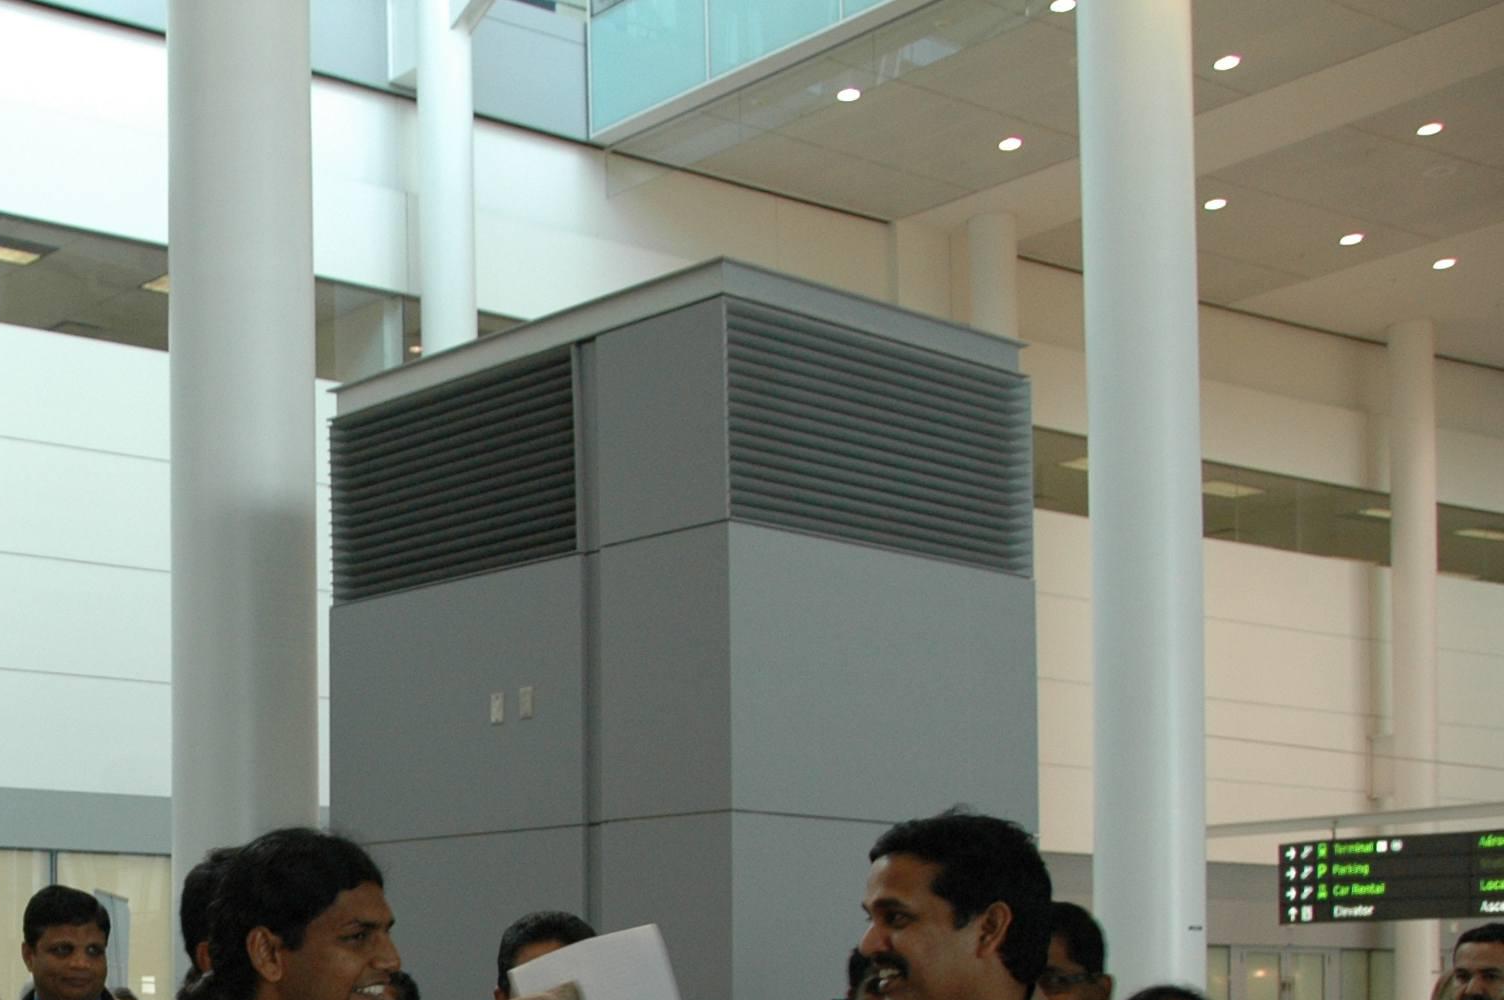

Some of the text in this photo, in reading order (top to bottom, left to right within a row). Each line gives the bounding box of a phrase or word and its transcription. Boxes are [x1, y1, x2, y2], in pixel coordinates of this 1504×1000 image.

[1334, 841, 1374, 855] Terminal
[1332, 863, 1370, 877] Parking
[1332, 881, 1385, 897] Car Rental
[1333, 904, 1375, 919] Elevator
